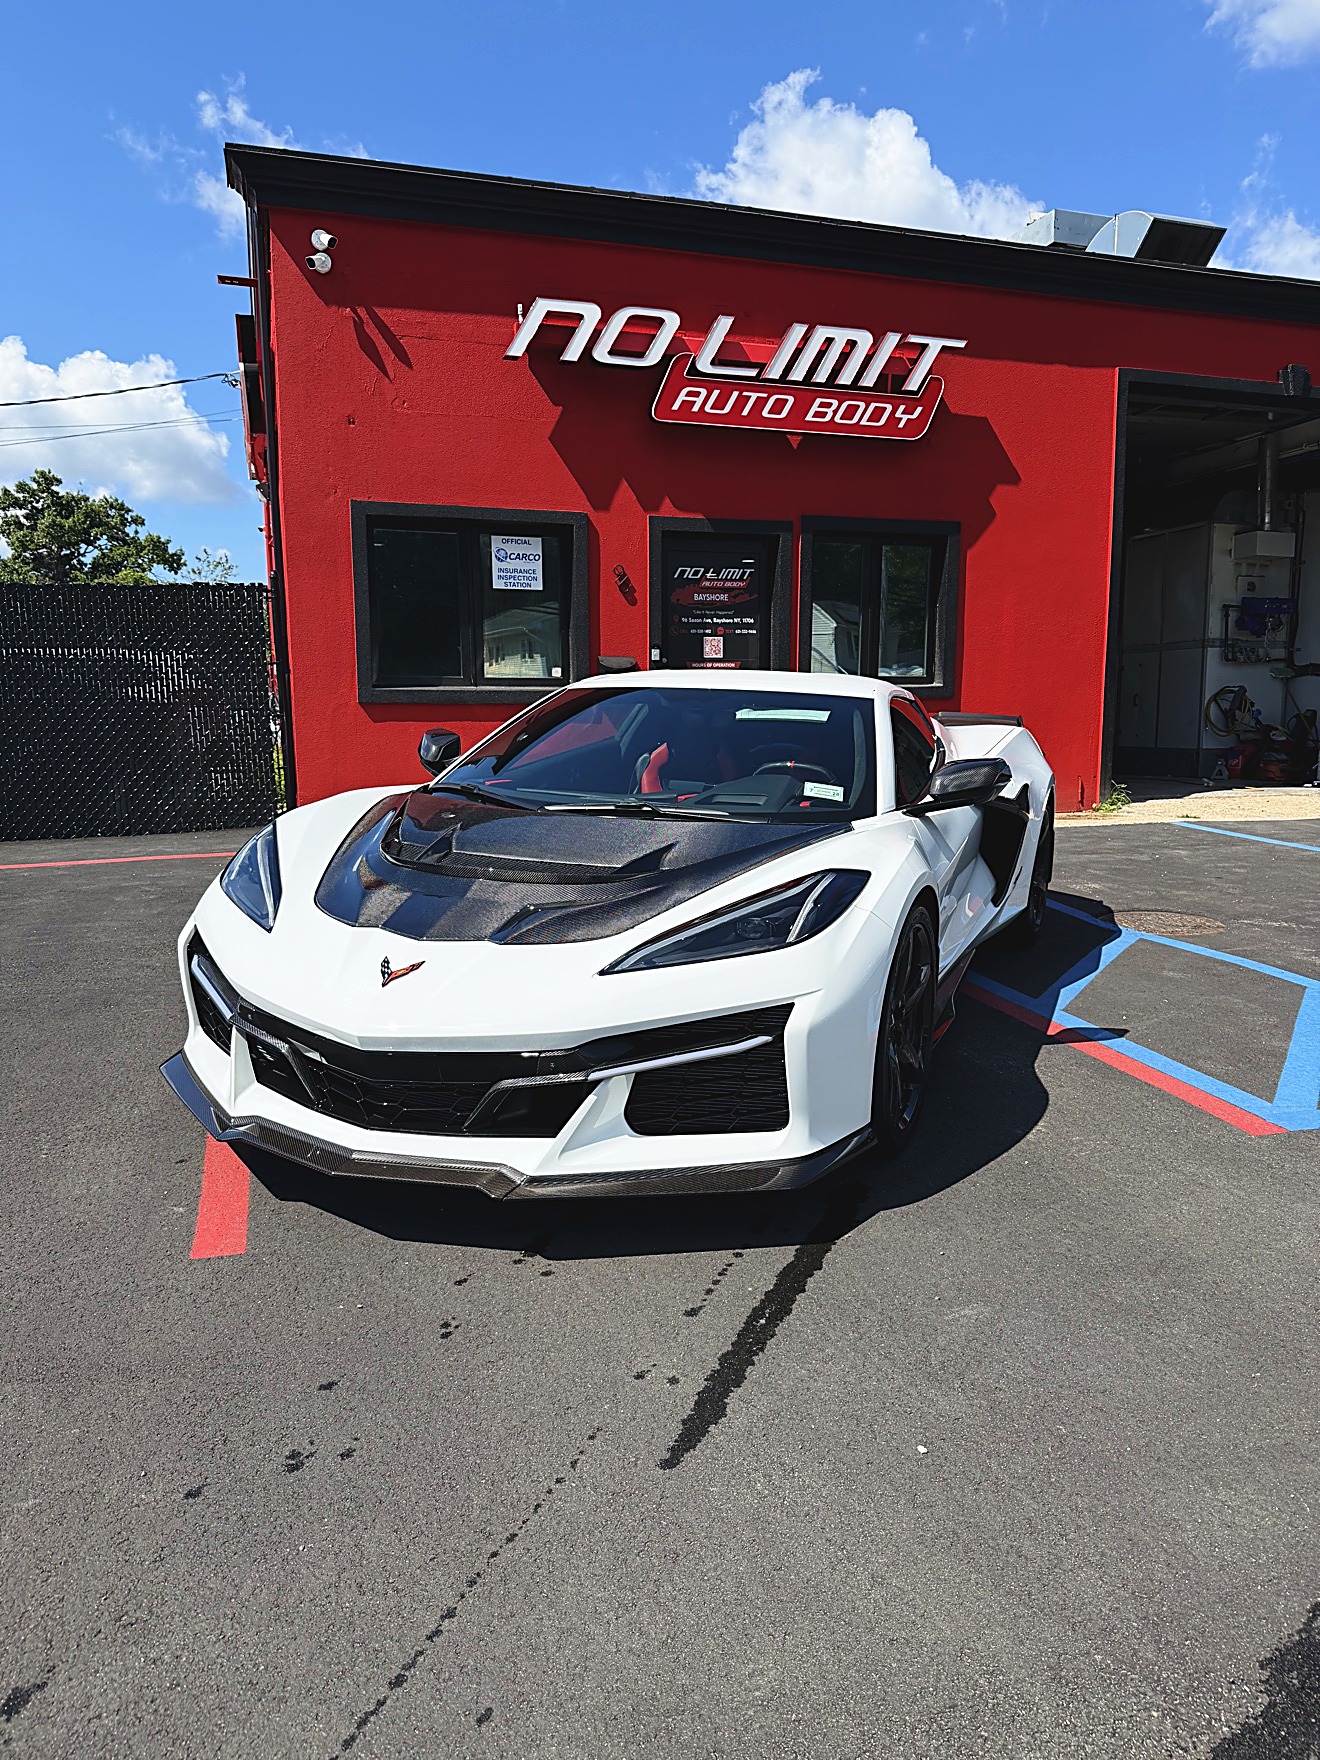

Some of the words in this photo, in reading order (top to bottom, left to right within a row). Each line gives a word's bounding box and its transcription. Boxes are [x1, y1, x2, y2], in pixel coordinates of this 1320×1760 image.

[503, 296, 682, 367] NO
[695, 315, 968, 392] LIMIT
[671, 387, 794, 420] AUTO
[804, 398, 924, 429] BODY
[509, 553, 540, 561] CARCO
[497, 567, 537, 575] INSURANCE
[673, 567, 705, 579] NO
[705, 568, 755, 579] LIMIT
[694, 593, 729, 601] BAYSHORE
